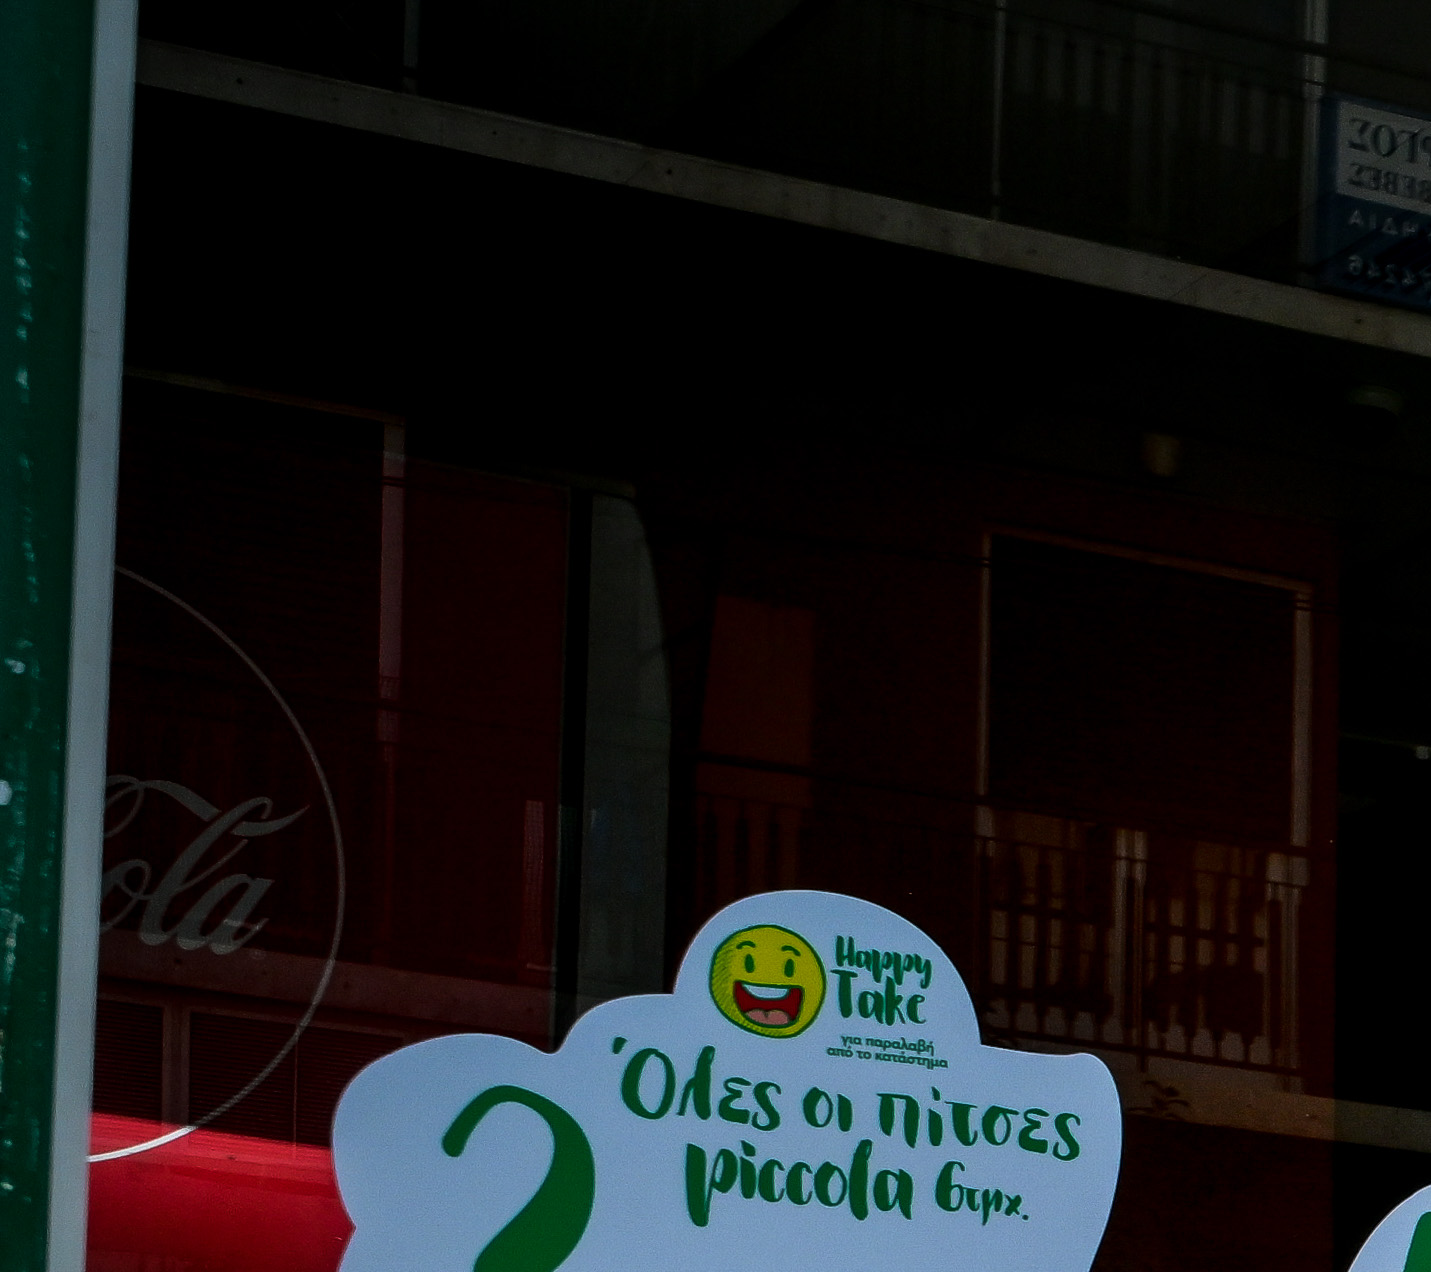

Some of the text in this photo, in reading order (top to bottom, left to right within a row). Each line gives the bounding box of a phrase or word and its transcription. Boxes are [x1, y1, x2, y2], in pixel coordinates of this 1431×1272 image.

[101, 775, 309, 955] ola
[830, 969, 926, 1026] Take
[836, 935, 931, 989] Happy
[802, 1087, 852, 1132] οι
[877, 1087, 1080, 1161] πίτσες
[684, 1139, 917, 1227] piccola
